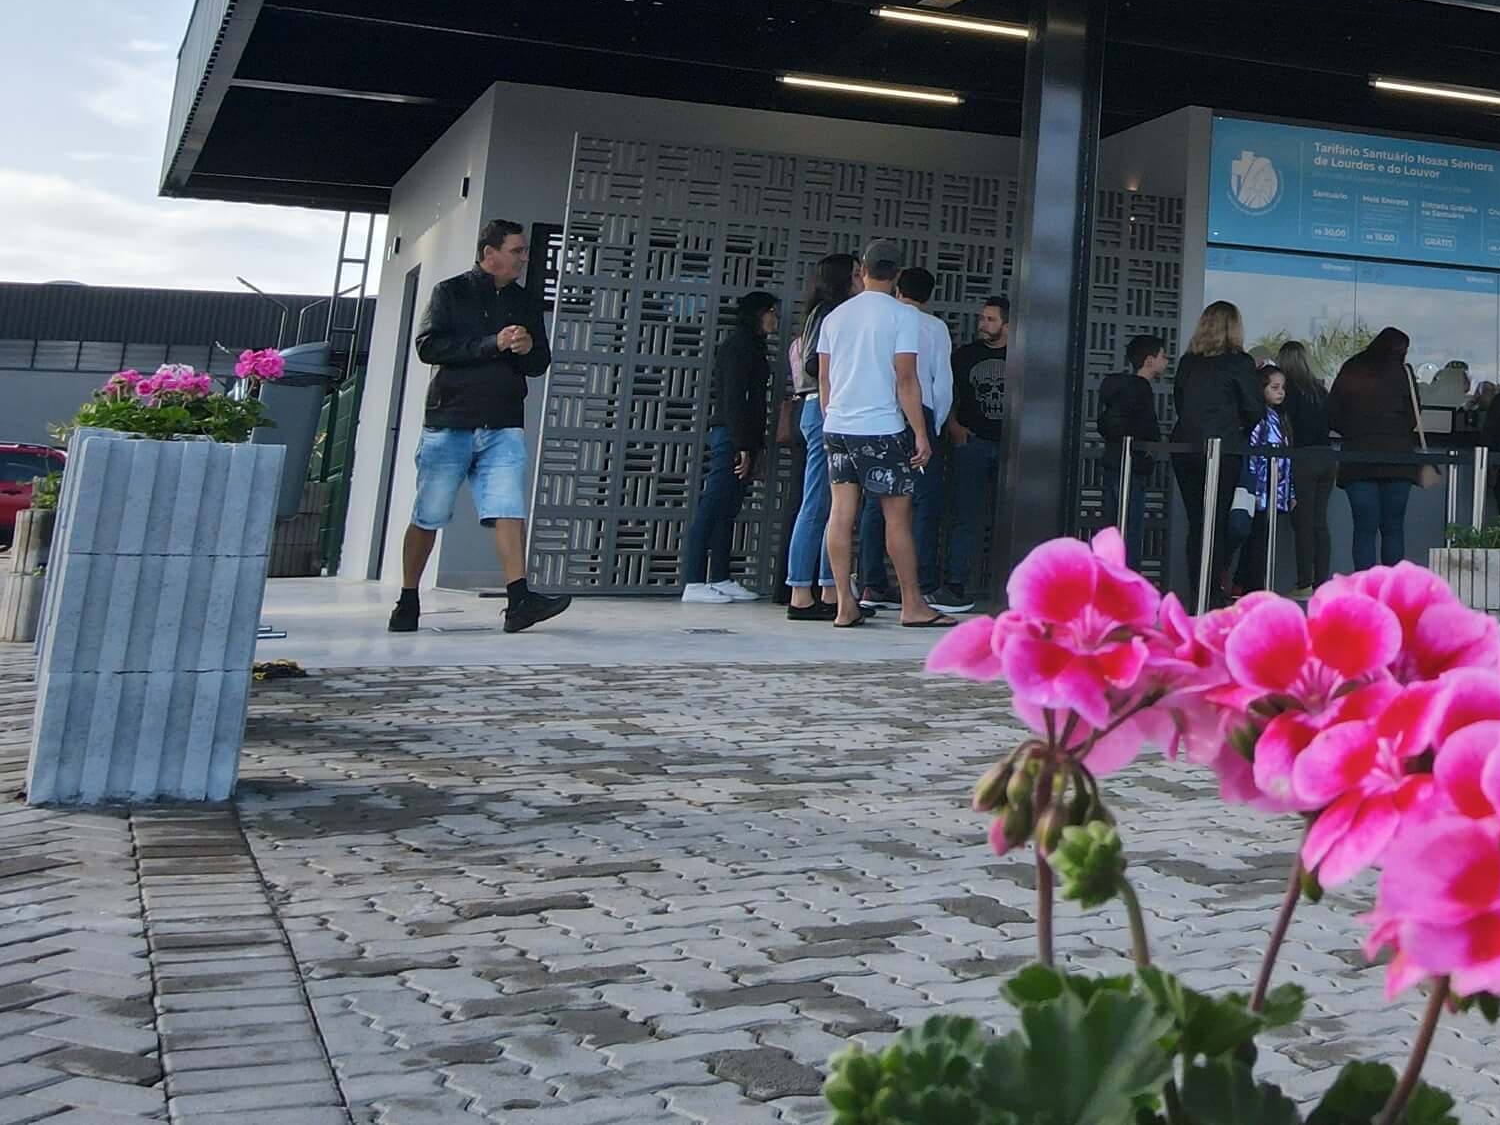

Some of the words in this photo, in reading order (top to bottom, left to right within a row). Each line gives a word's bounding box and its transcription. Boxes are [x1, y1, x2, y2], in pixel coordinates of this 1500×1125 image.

[1313, 141, 1360, 156] Tarifário
[1362, 147, 1415, 163] Santuário
[1417, 154, 1449, 167] Nossa
[1450, 157, 1496, 172] Senhora
[1313, 155, 1328, 165] de
[1331, 157, 1375, 171] Lourdes
[1378, 164, 1385, 172] e
[1387, 163, 1401, 174] do
[1404, 165, 1440, 178] Louvor
